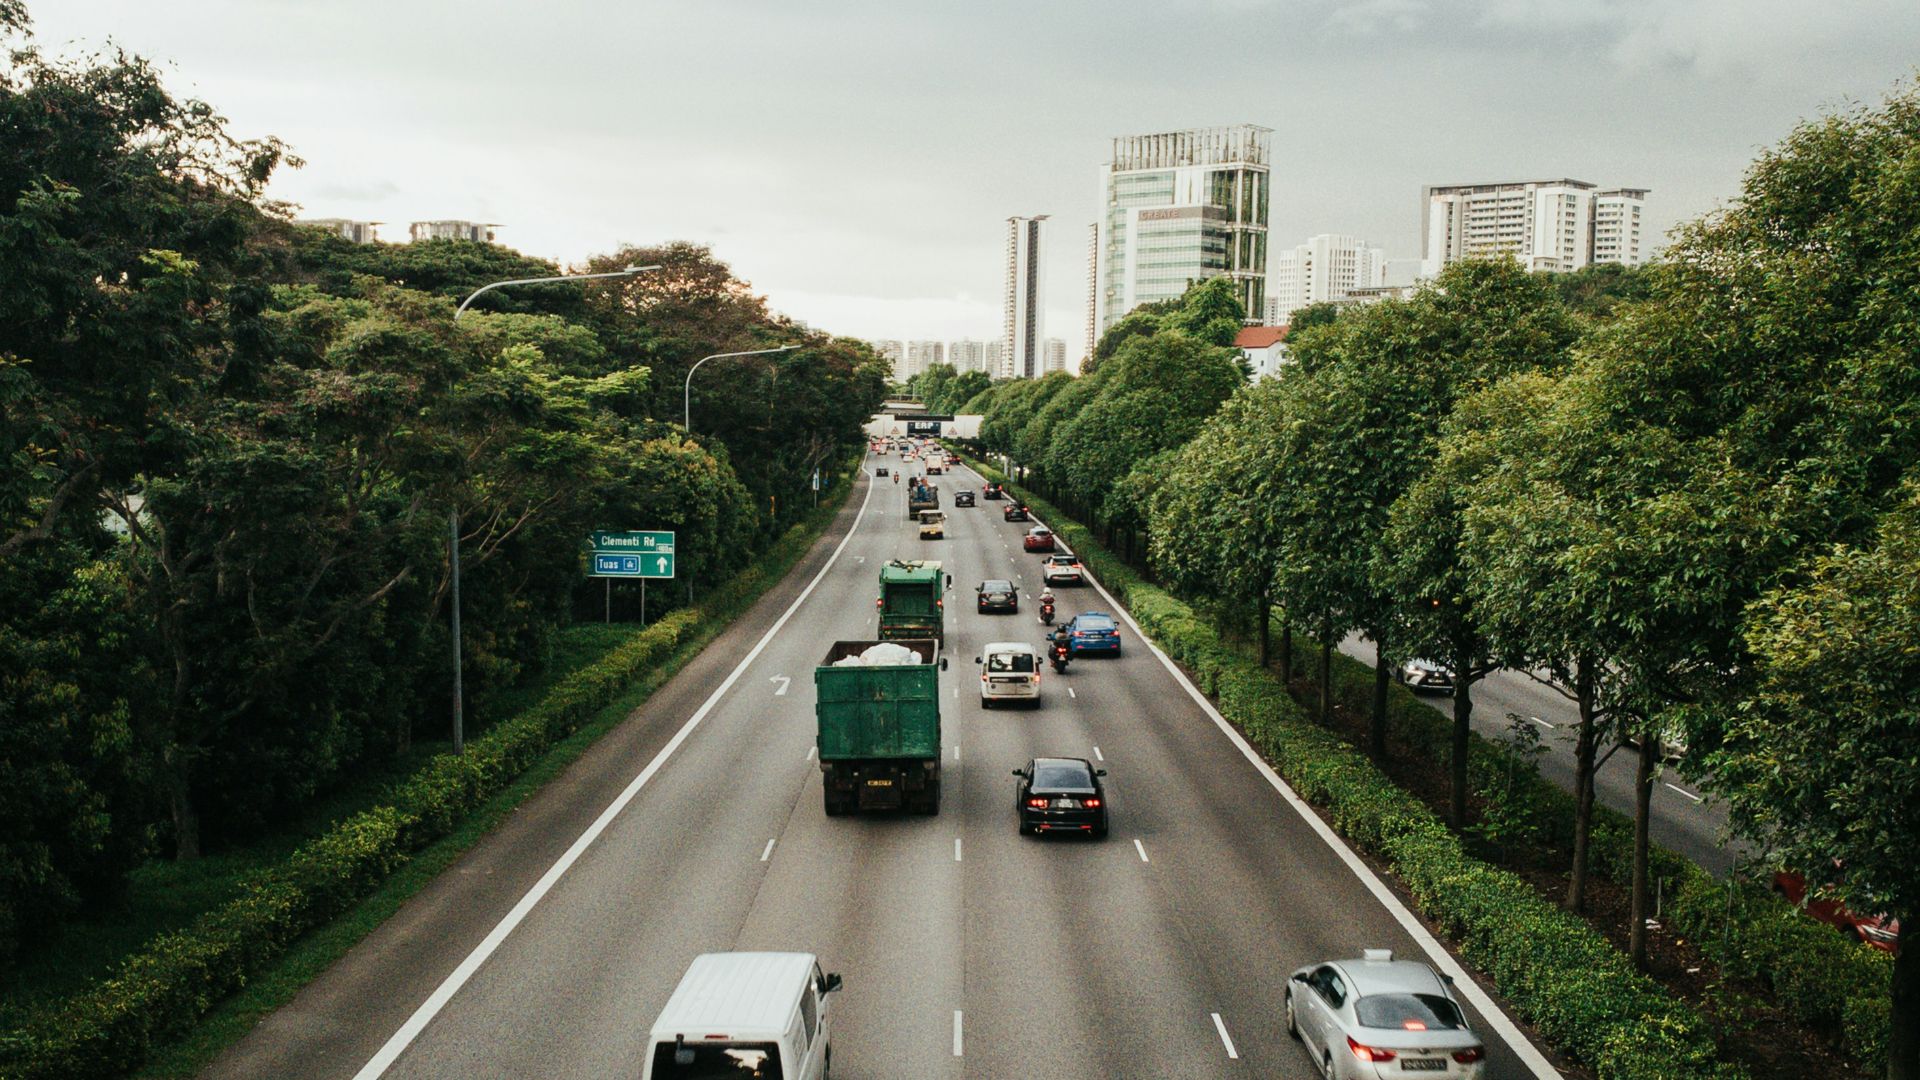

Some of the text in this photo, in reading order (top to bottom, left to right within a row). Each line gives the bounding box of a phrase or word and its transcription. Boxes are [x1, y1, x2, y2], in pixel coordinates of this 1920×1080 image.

[1142, 209, 1178, 220] CREATE
[601, 536, 655, 547] Clementi Rd
[598, 558, 618, 569] Tuas
